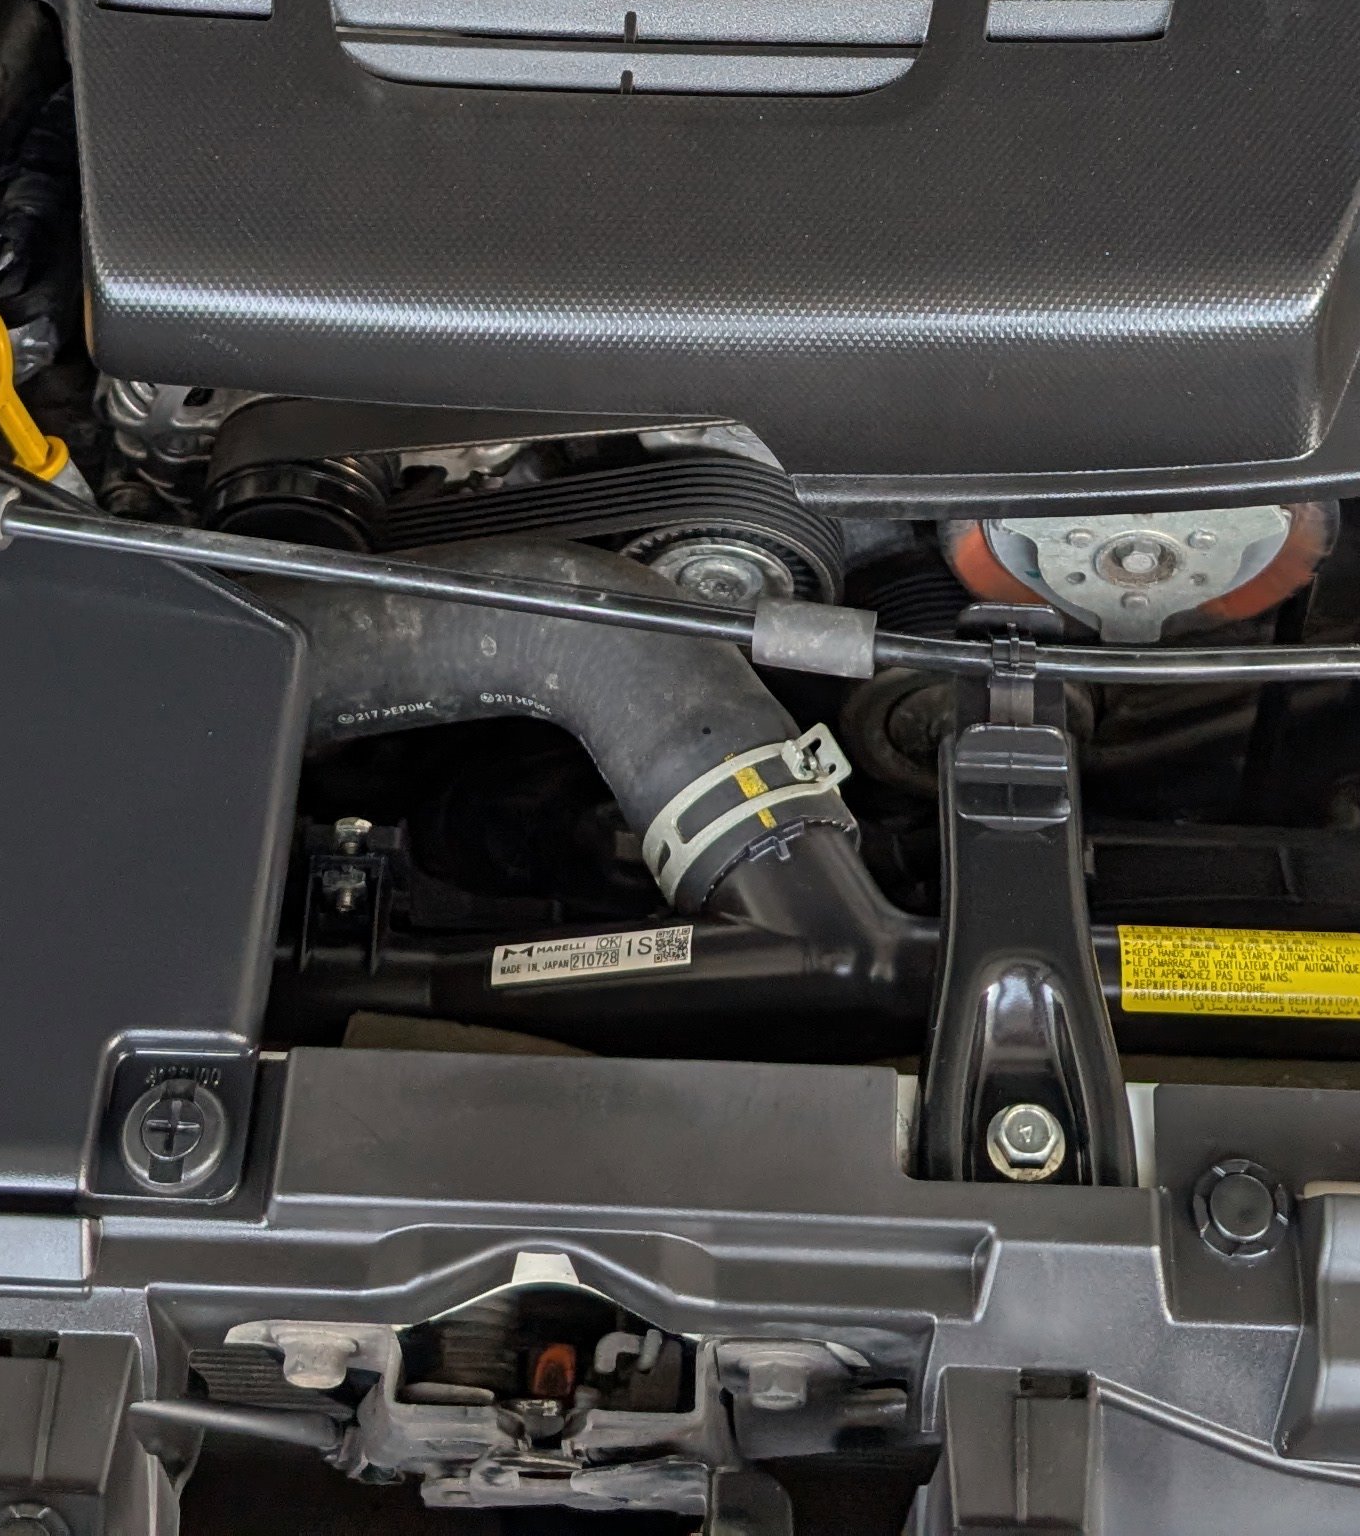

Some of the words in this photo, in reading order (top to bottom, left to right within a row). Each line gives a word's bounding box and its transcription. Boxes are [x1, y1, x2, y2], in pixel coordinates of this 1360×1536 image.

[495, 694, 513, 703] 217
[356, 711, 378, 721] 217
[537, 942, 585, 954] MARELLI
[599, 937, 618, 949] OK
[1133, 948, 1154, 957] KEEP
[1158, 949, 1184, 958] HANDS
[1242, 952, 1273, 961] STARTS
[500, 965, 520, 975] MADE
[542, 960, 569, 972] JAPAN
[572, 951, 617, 968] 210728
[1199, 960, 1209, 969] DU
[1213, 960, 1269, 970] VENTILATEUR
[1161, 970, 1210, 979] APPROCHEZ
[1216, 971, 1233, 980] PAS
[1238, 972, 1255, 980] LES
